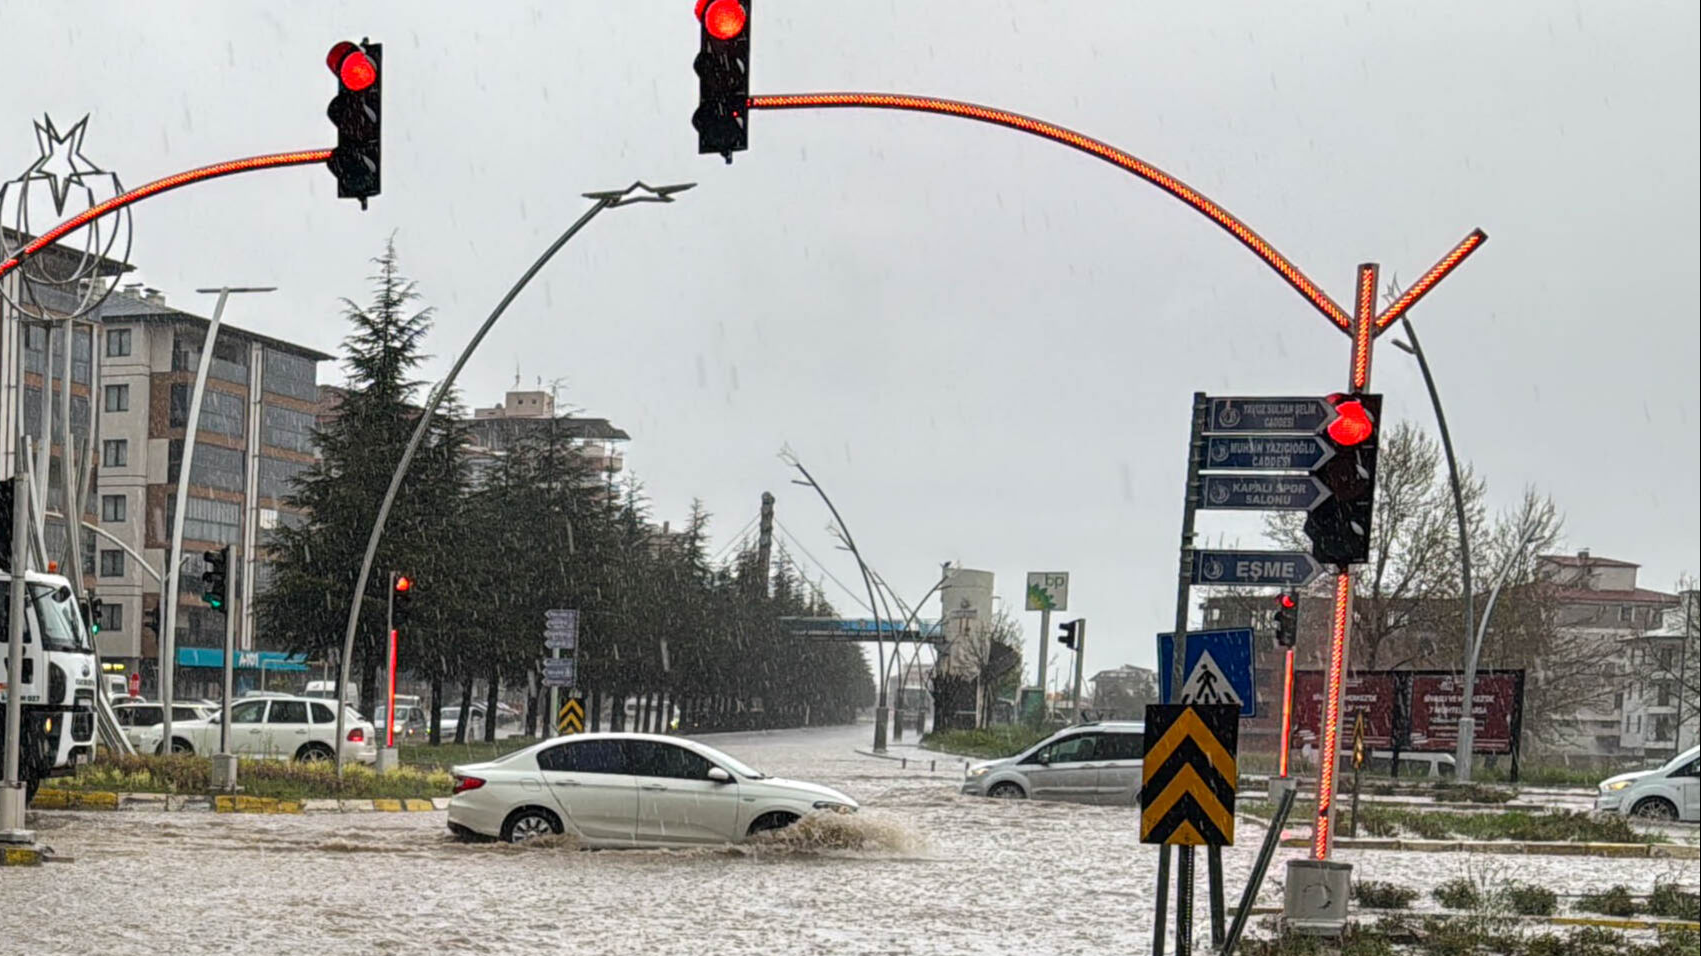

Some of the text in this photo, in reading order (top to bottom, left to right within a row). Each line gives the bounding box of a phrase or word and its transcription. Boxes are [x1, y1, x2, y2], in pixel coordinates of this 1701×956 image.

[1264, 416, 1294, 428] CADDESİ
[1230, 441, 1263, 454] MUHSİN
[1251, 455, 1292, 467] CADDESİ
[1232, 482, 1307, 495] KAPALI SPOR
[1245, 495, 1292, 505] SALONU
[1235, 561, 1296, 582] EŞME
[1045, 573, 1065, 590] bp
